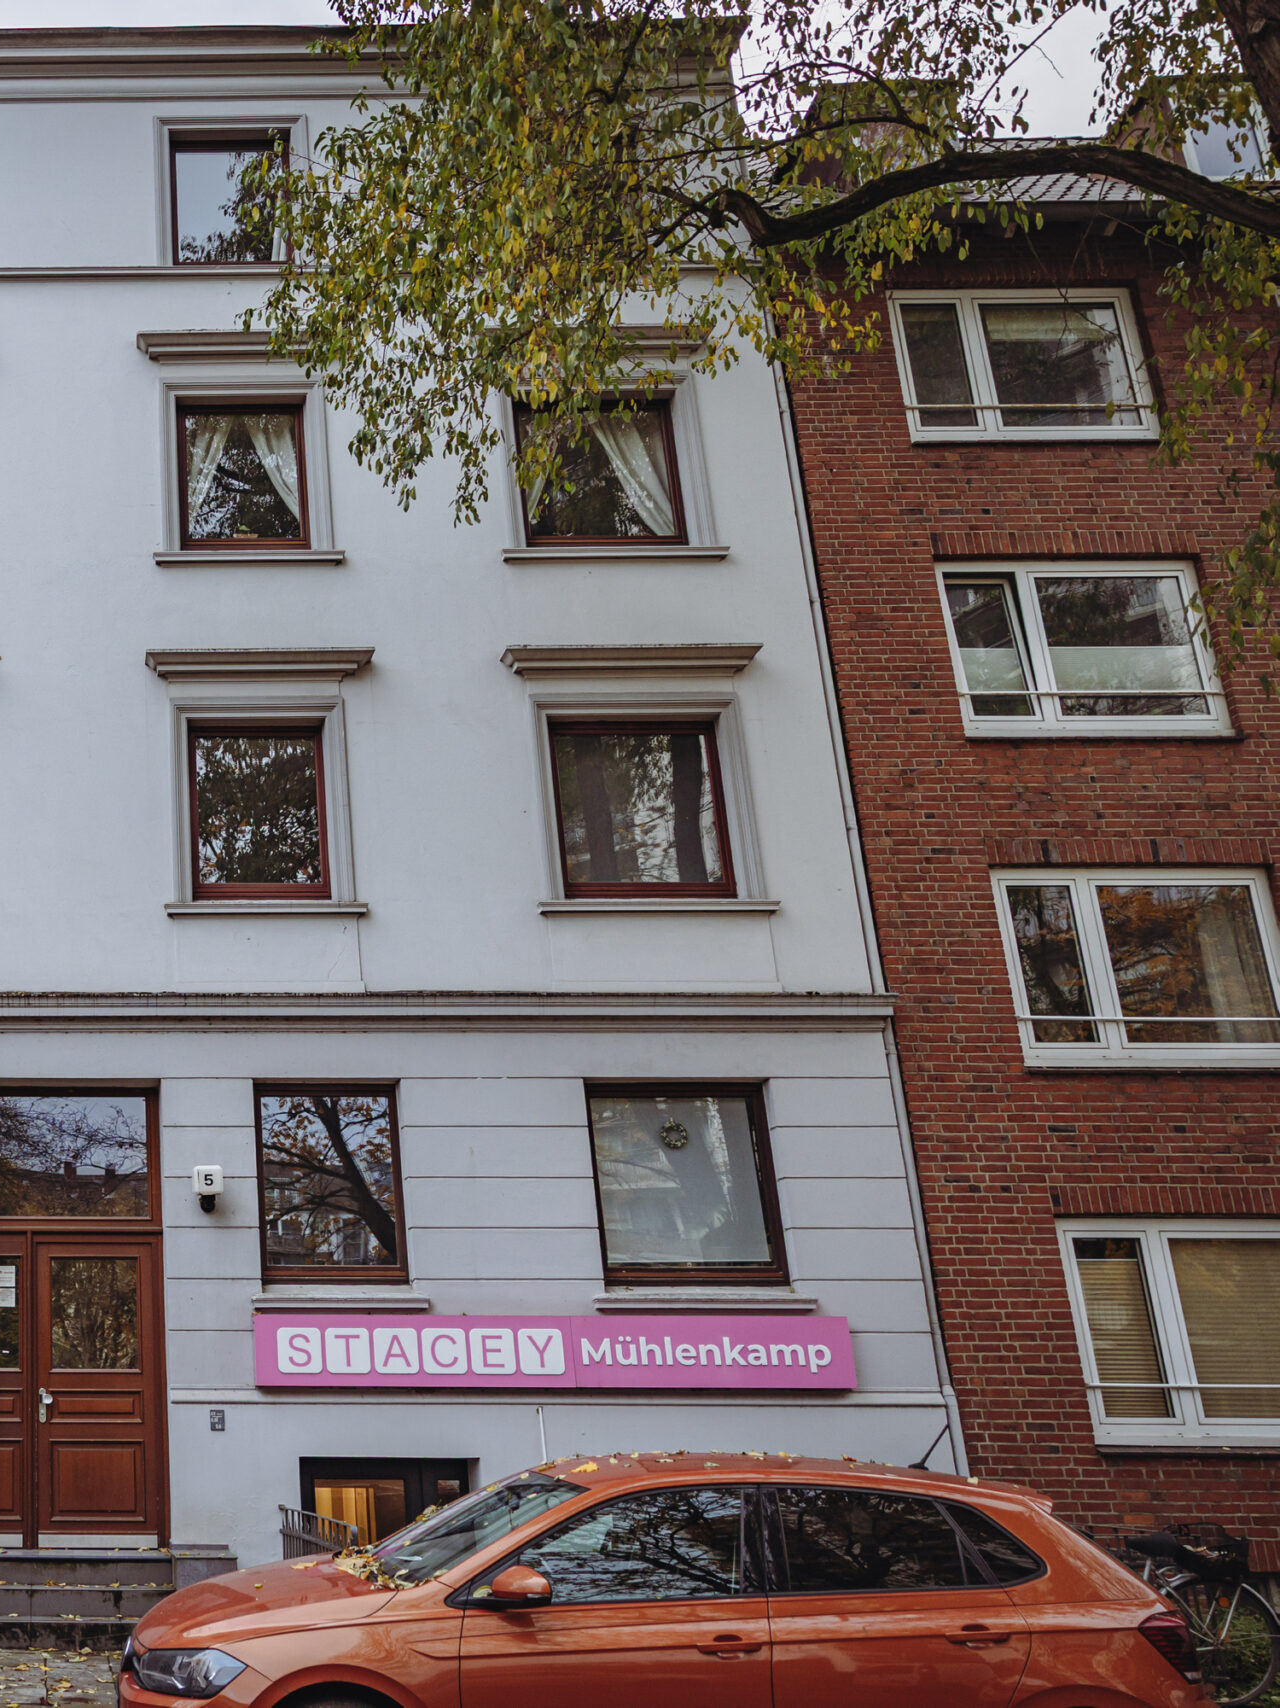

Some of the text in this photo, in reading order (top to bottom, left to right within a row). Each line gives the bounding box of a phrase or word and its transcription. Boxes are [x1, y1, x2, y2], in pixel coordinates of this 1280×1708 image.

[204, 1173, 214, 1187] 5
[287, 1333, 833, 1374] STACEY Mühlenkamp
